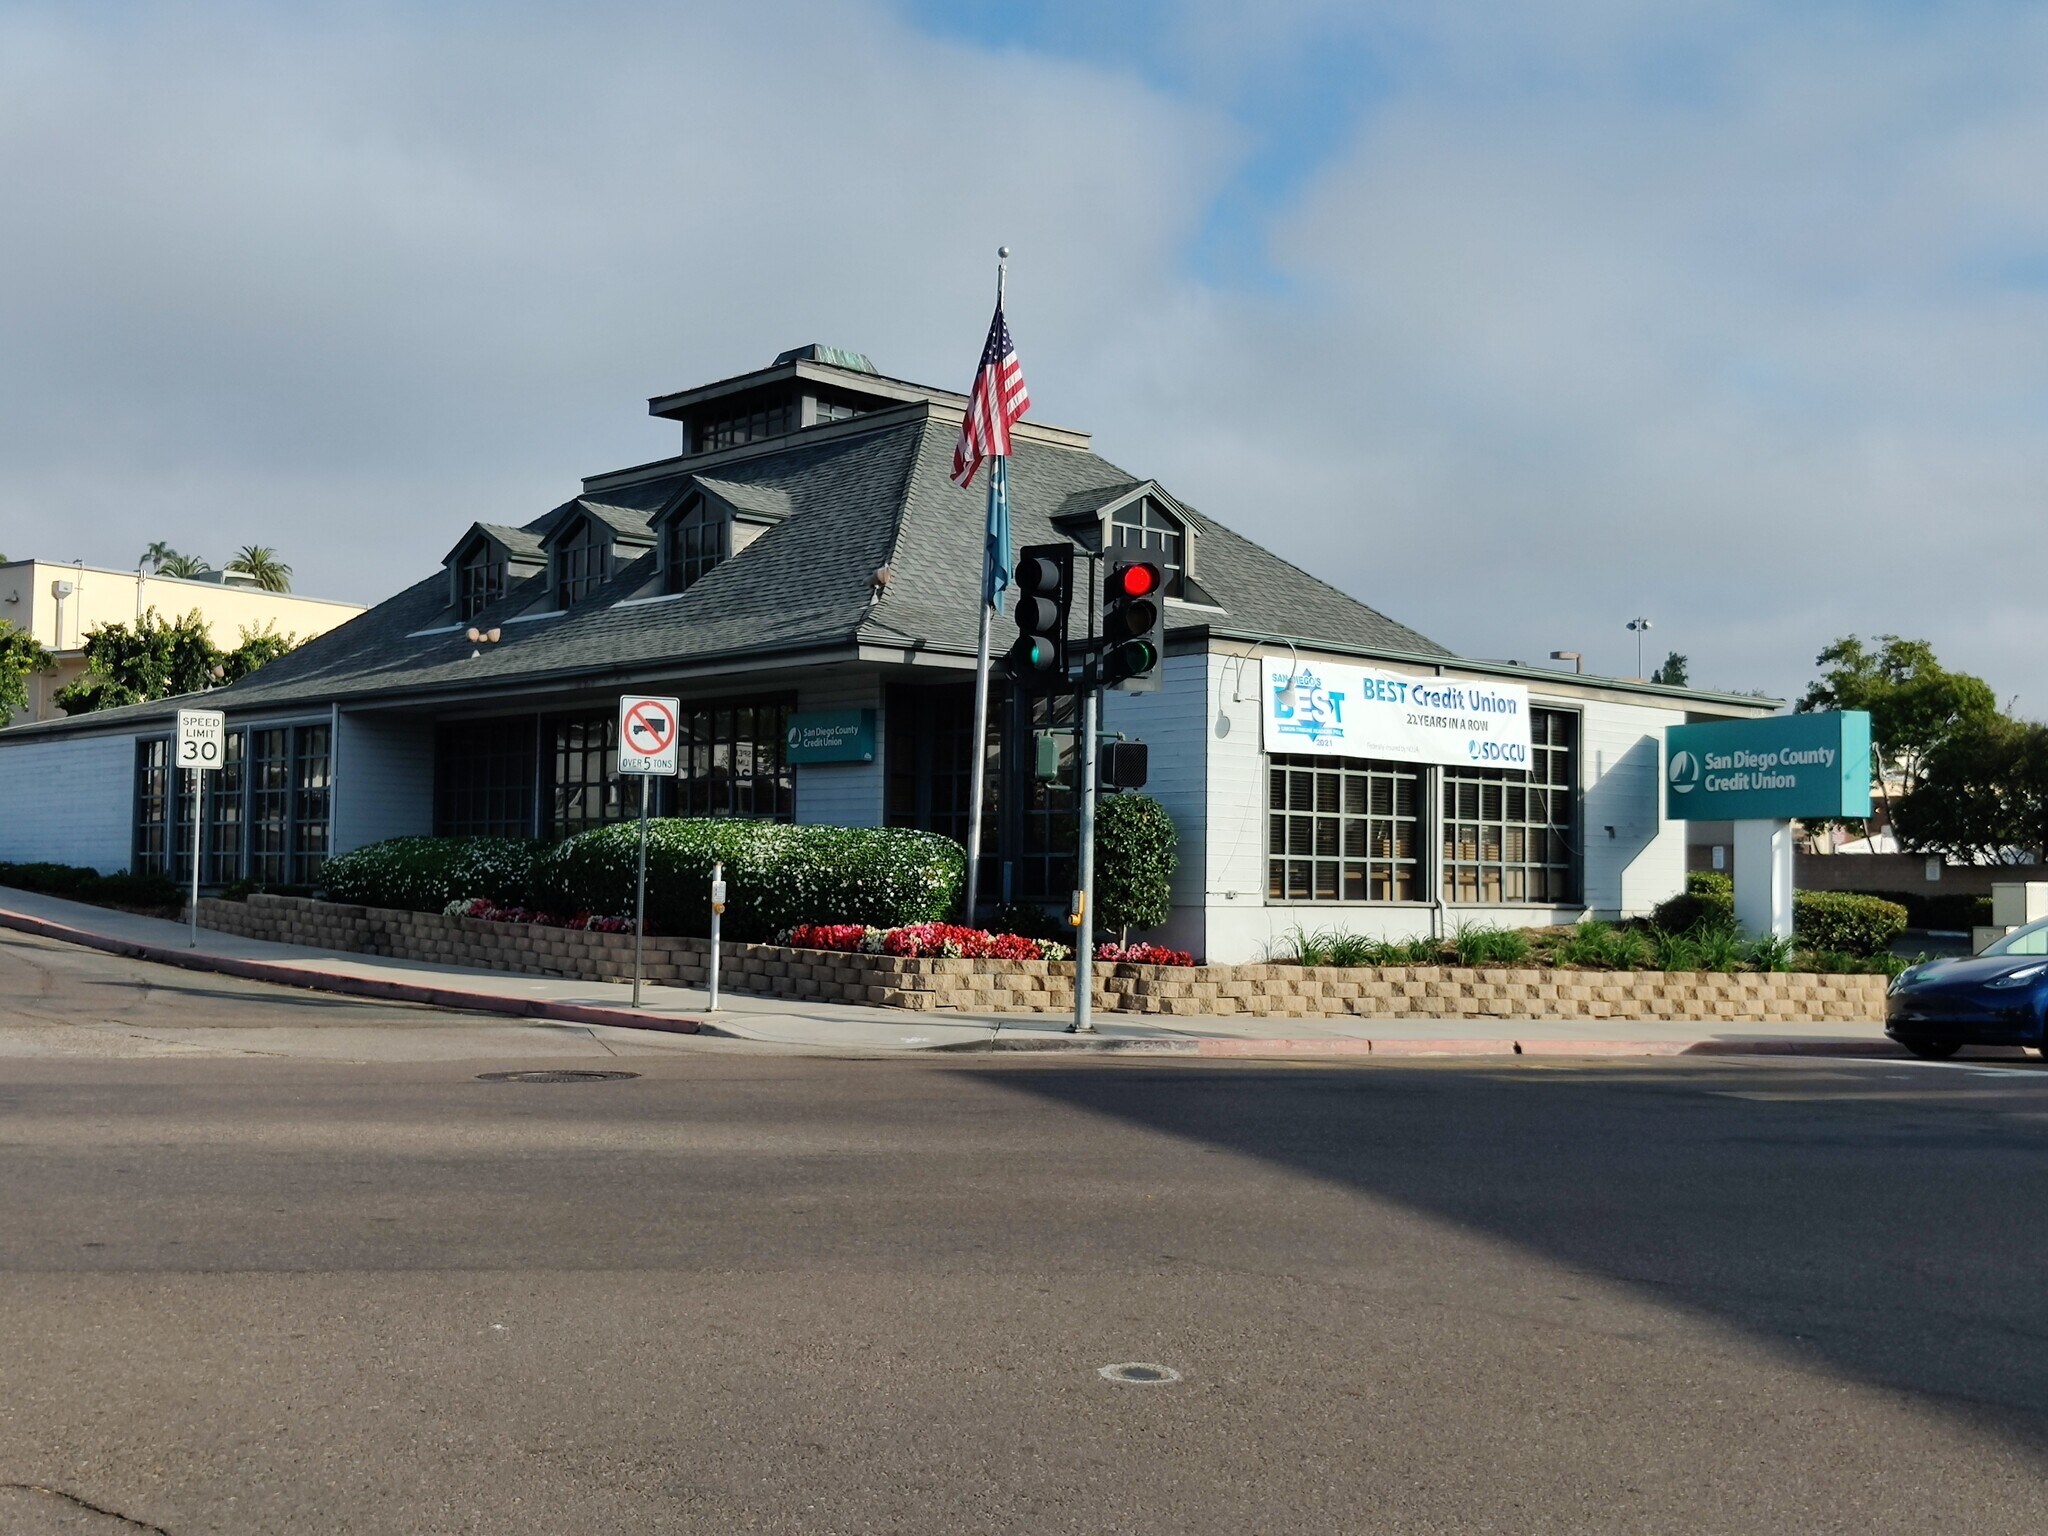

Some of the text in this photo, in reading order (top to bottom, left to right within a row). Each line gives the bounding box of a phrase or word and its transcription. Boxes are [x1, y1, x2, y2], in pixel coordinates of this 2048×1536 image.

[1272, 673, 1288, 682] SAN
[1363, 678, 1517, 714] BEST Credit Union
[1274, 686, 1345, 723] BEST
[183, 717, 220, 727] SPEED
[1406, 713, 1489, 732] 22 YEARS IN A ROW
[186, 729, 215, 738] LIMIT
[803, 725, 859, 738] San Diego County
[183, 741, 217, 760] 30
[803, 737, 842, 748] Credit Union
[1316, 739, 1333, 747] 2021
[1482, 741, 1526, 763] SDCCU
[1705, 747, 1835, 771] San Diego County
[623, 757, 672, 770] OVER 5 TONS
[1705, 771, 1795, 792] Credit Union
